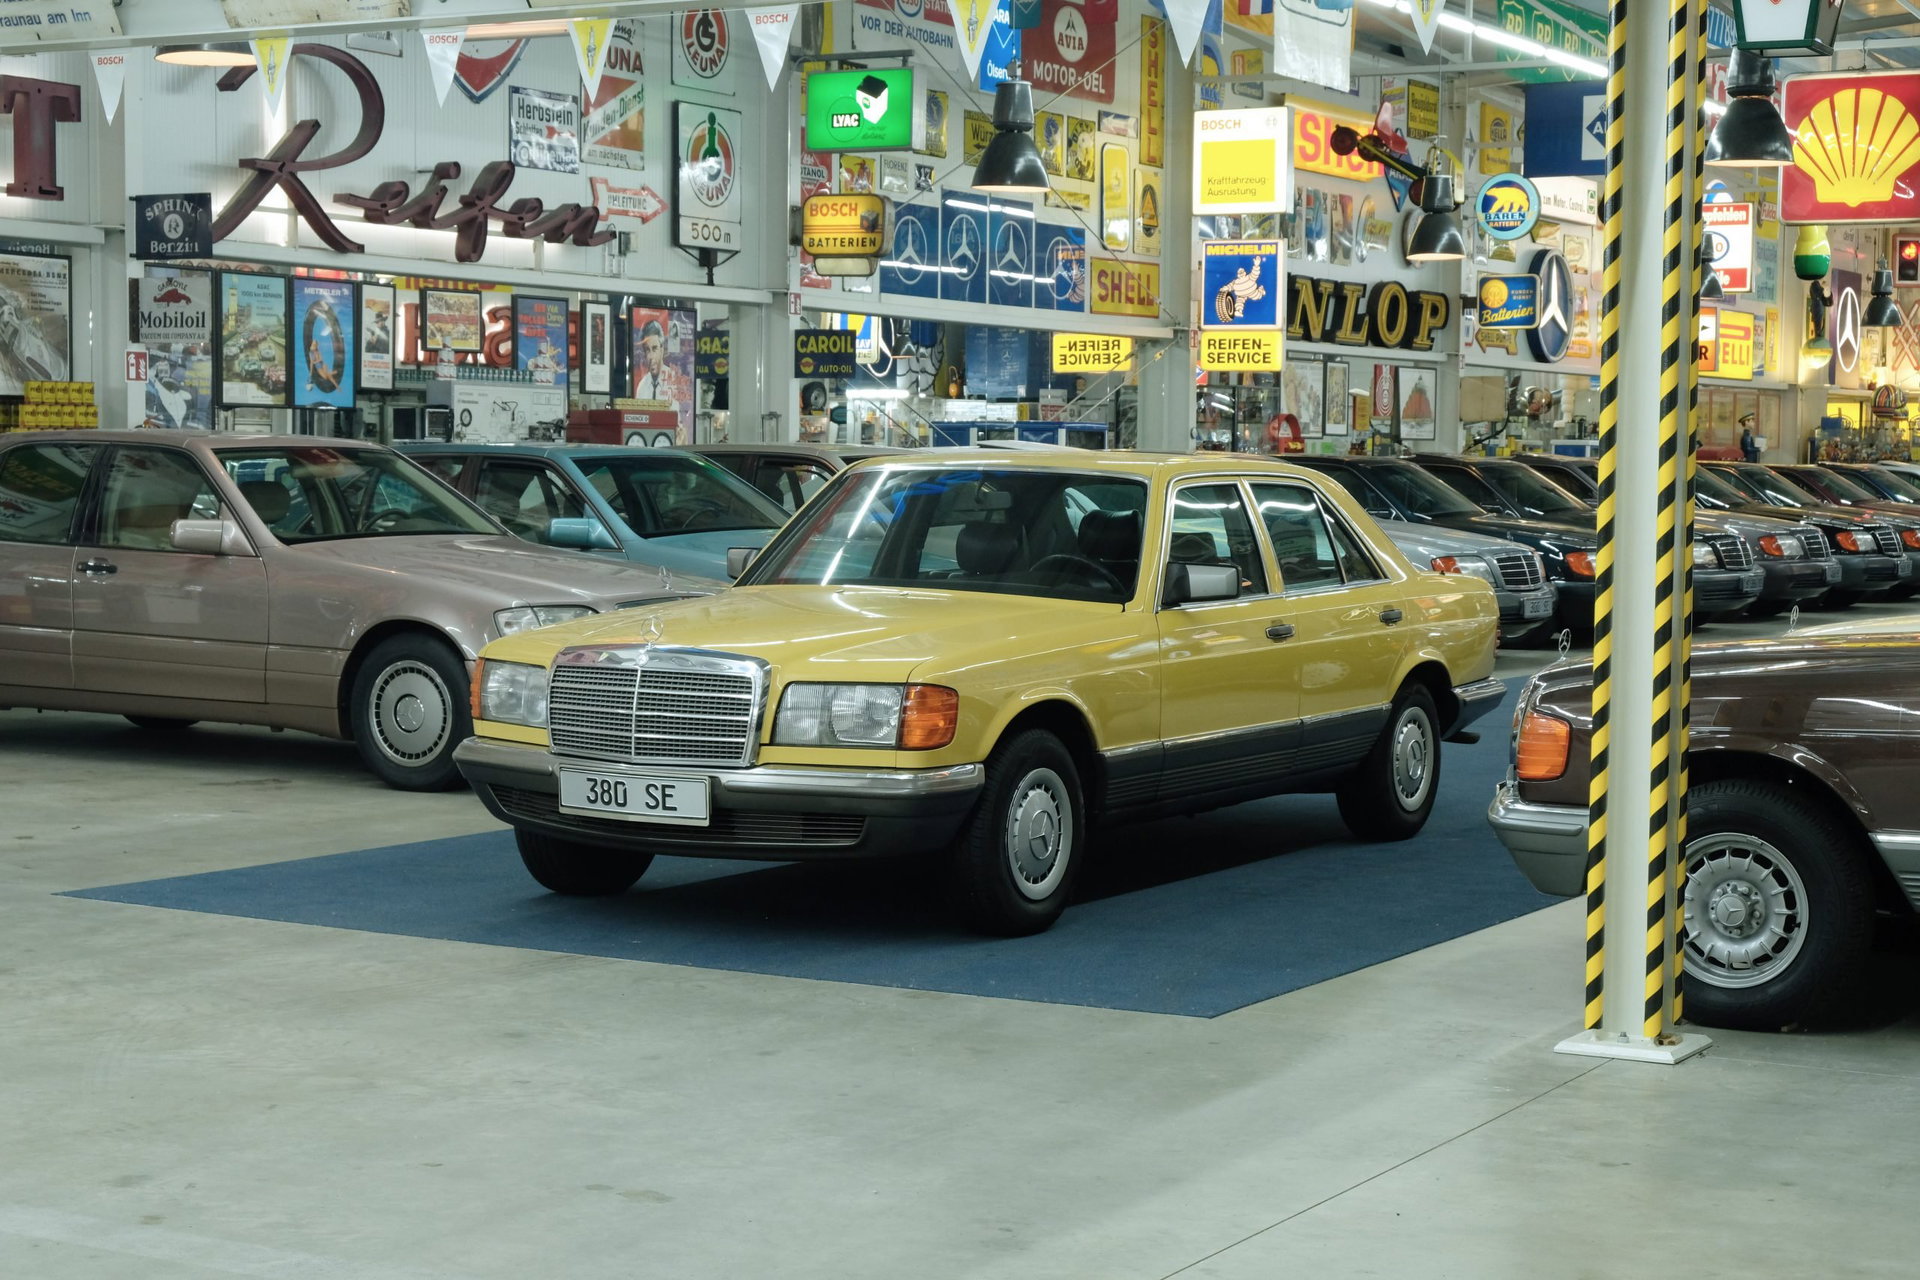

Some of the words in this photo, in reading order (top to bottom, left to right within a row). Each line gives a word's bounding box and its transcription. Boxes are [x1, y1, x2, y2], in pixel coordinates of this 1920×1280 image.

[47, 13, 67, 24] am
[71, 9, 92, 22] Inn
[755, 14, 789, 25] BOSCH
[429, 35, 458, 44] BOSCH
[860, 14, 882, 32] VOR
[884, 20, 904, 38] DER
[905, 26, 954, 49] AUTOBAHN
[1057, 32, 1085, 51] AVIA
[97, 55, 124, 66] BOSCH
[686, 41, 725, 72] LEUNA
[1033, 59, 1106, 95] MOTOR-OEL
[1145, 20, 1159, 164] SHELL
[517, 97, 573, 126] Herbstein
[832, 113, 860, 128] LYAC
[1201, 119, 1242, 131] BOSCH
[883, 158, 909, 172] FLORENZ
[693, 177, 731, 202] LEUNA
[145, 198, 204, 221] SPHIN
[608, 193, 647, 211] UMLEITUNG
[809, 202, 858, 217] BOSCH
[691, 222, 721, 242] 500
[723, 232, 731, 243] m
[808, 236, 878, 248] BATTERIEN
[1206, 244, 1277, 256] MICHELIN
[304, 286, 342, 298] METZELER
[1096, 268, 1156, 307] SHELL
[139, 311, 206, 328] Mobiloil
[1480, 304, 1534, 324] Batterien
[796, 335, 854, 354] CAROIL
[1207, 338, 1271, 350] REIFEN-
[1207, 352, 1272, 364] SERVICE
[818, 364, 853, 374] AUTO-OIL
[586, 777, 628, 808] 380
[645, 783, 678, 812] SE
